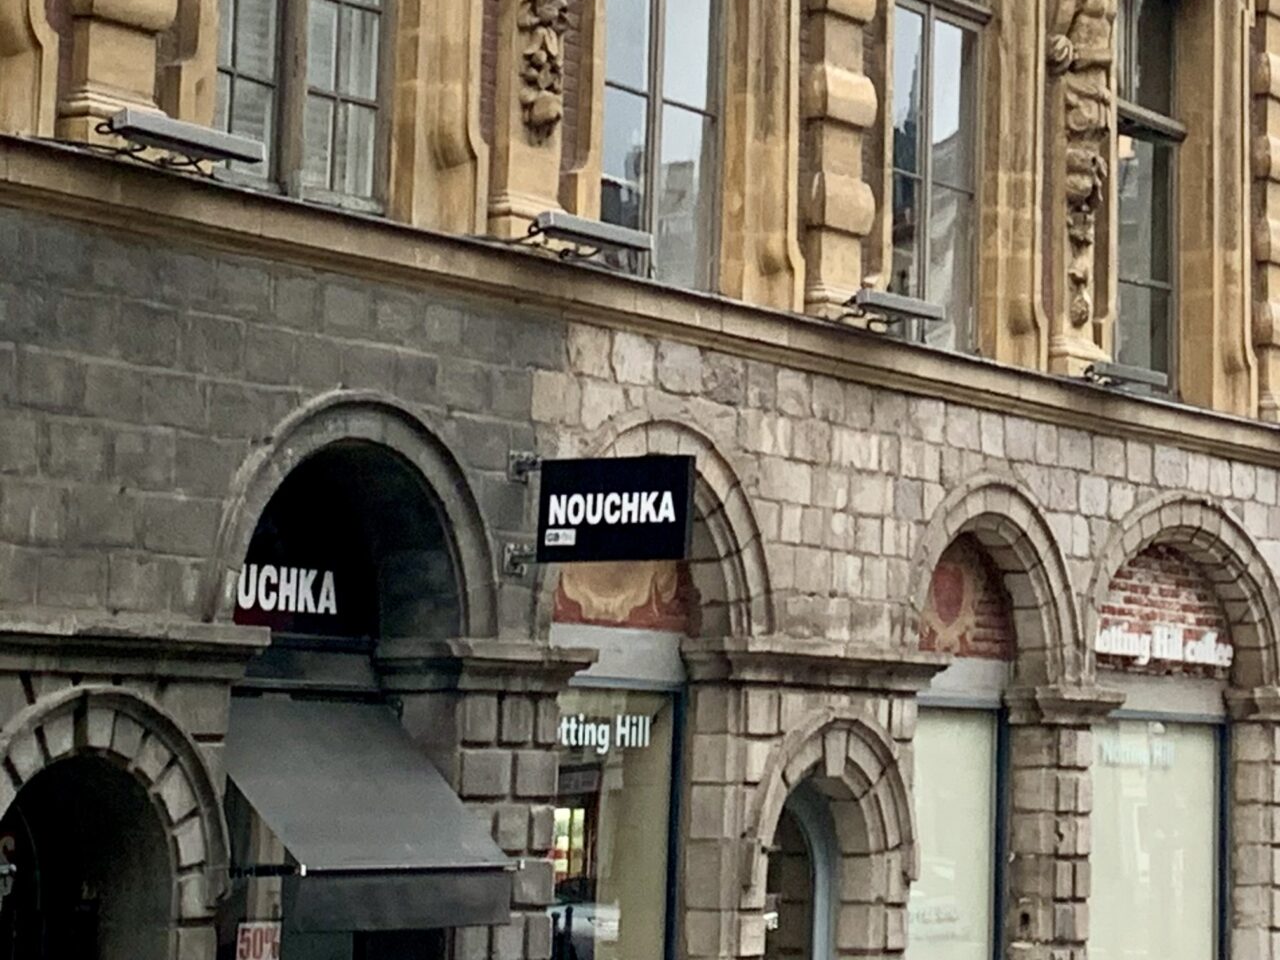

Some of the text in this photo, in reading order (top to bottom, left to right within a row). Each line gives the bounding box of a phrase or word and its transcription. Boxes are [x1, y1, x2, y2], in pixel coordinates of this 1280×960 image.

[548, 491, 676, 525] NOUCHKA
[557, 712, 651, 755] tting Hill
